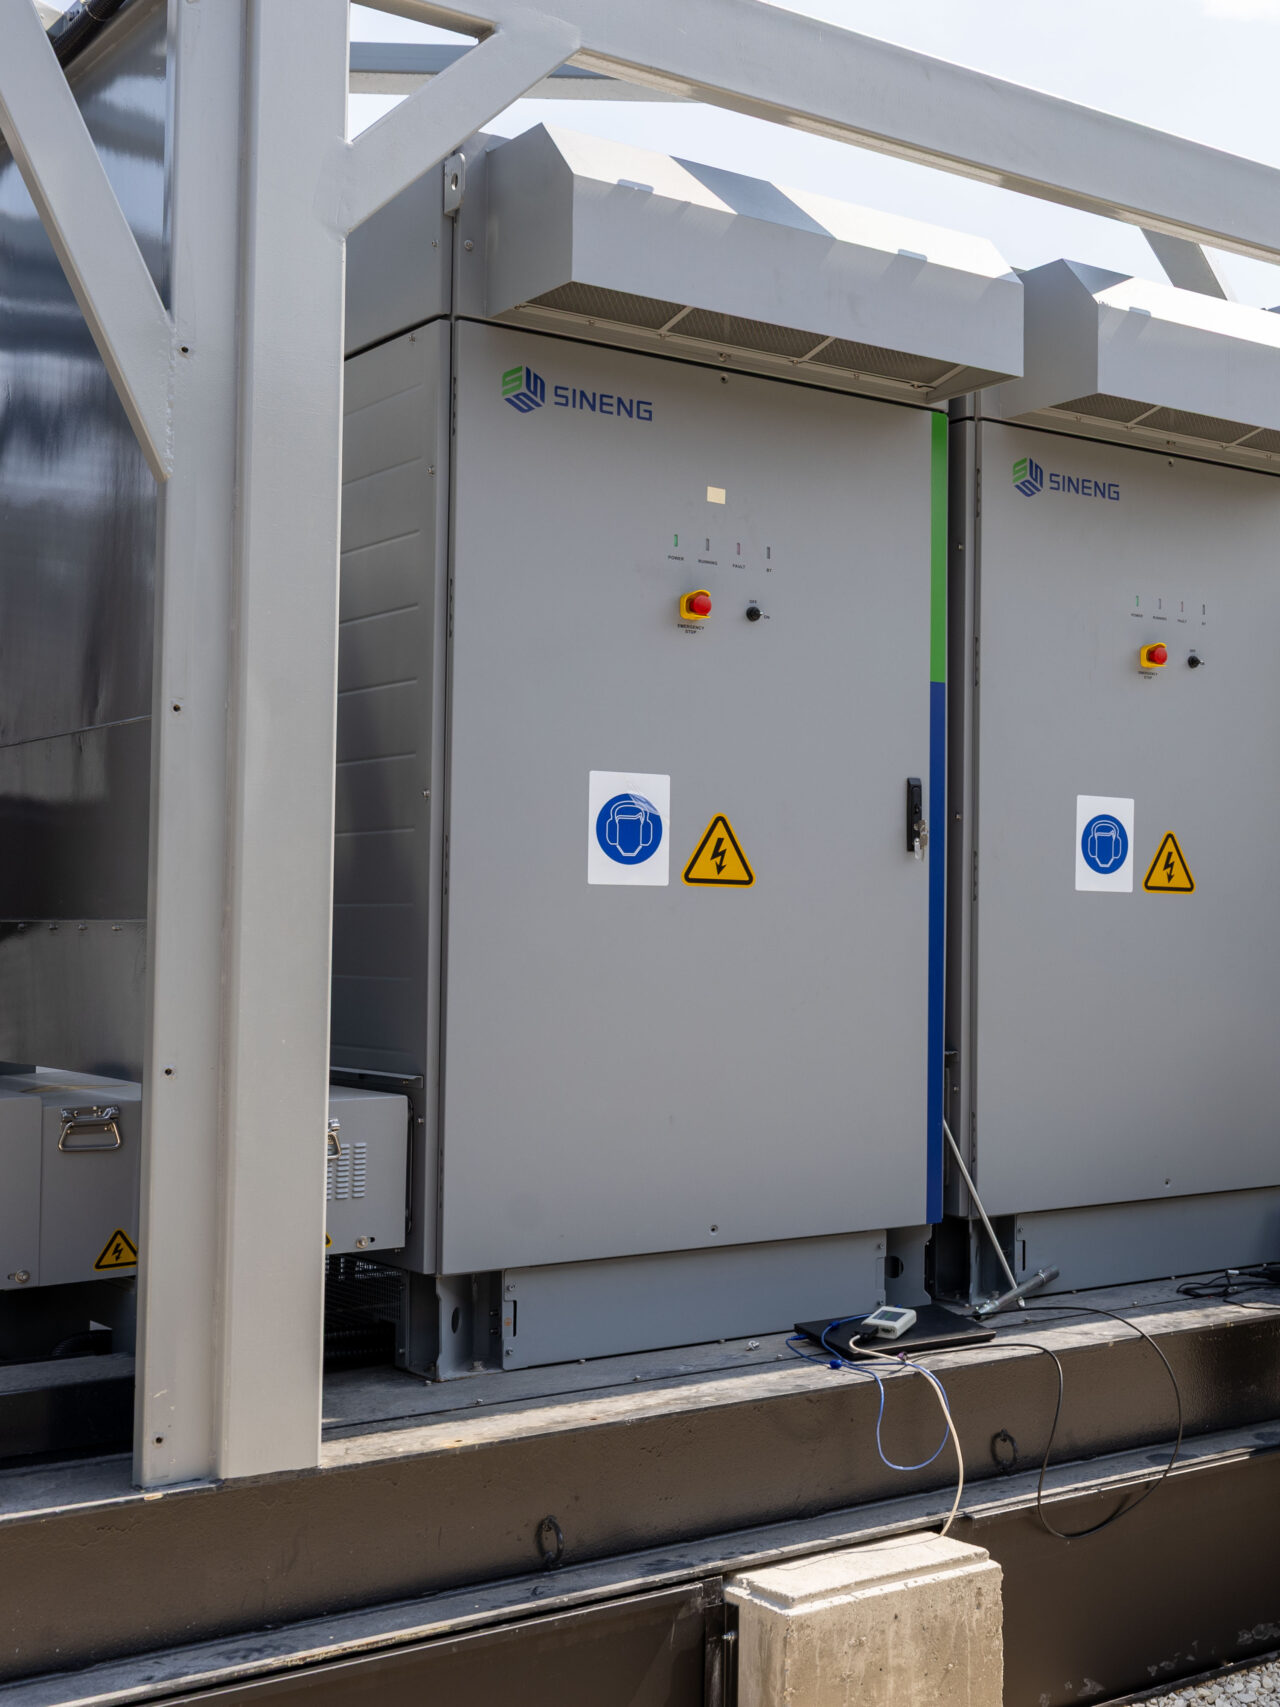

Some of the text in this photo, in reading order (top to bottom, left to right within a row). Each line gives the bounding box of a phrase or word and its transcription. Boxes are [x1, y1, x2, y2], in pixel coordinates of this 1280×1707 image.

[553, 384, 653, 422] SINENG
[1049, 472, 1120, 501] SINENG
[677, 623, 705, 631] EMERGENCY
